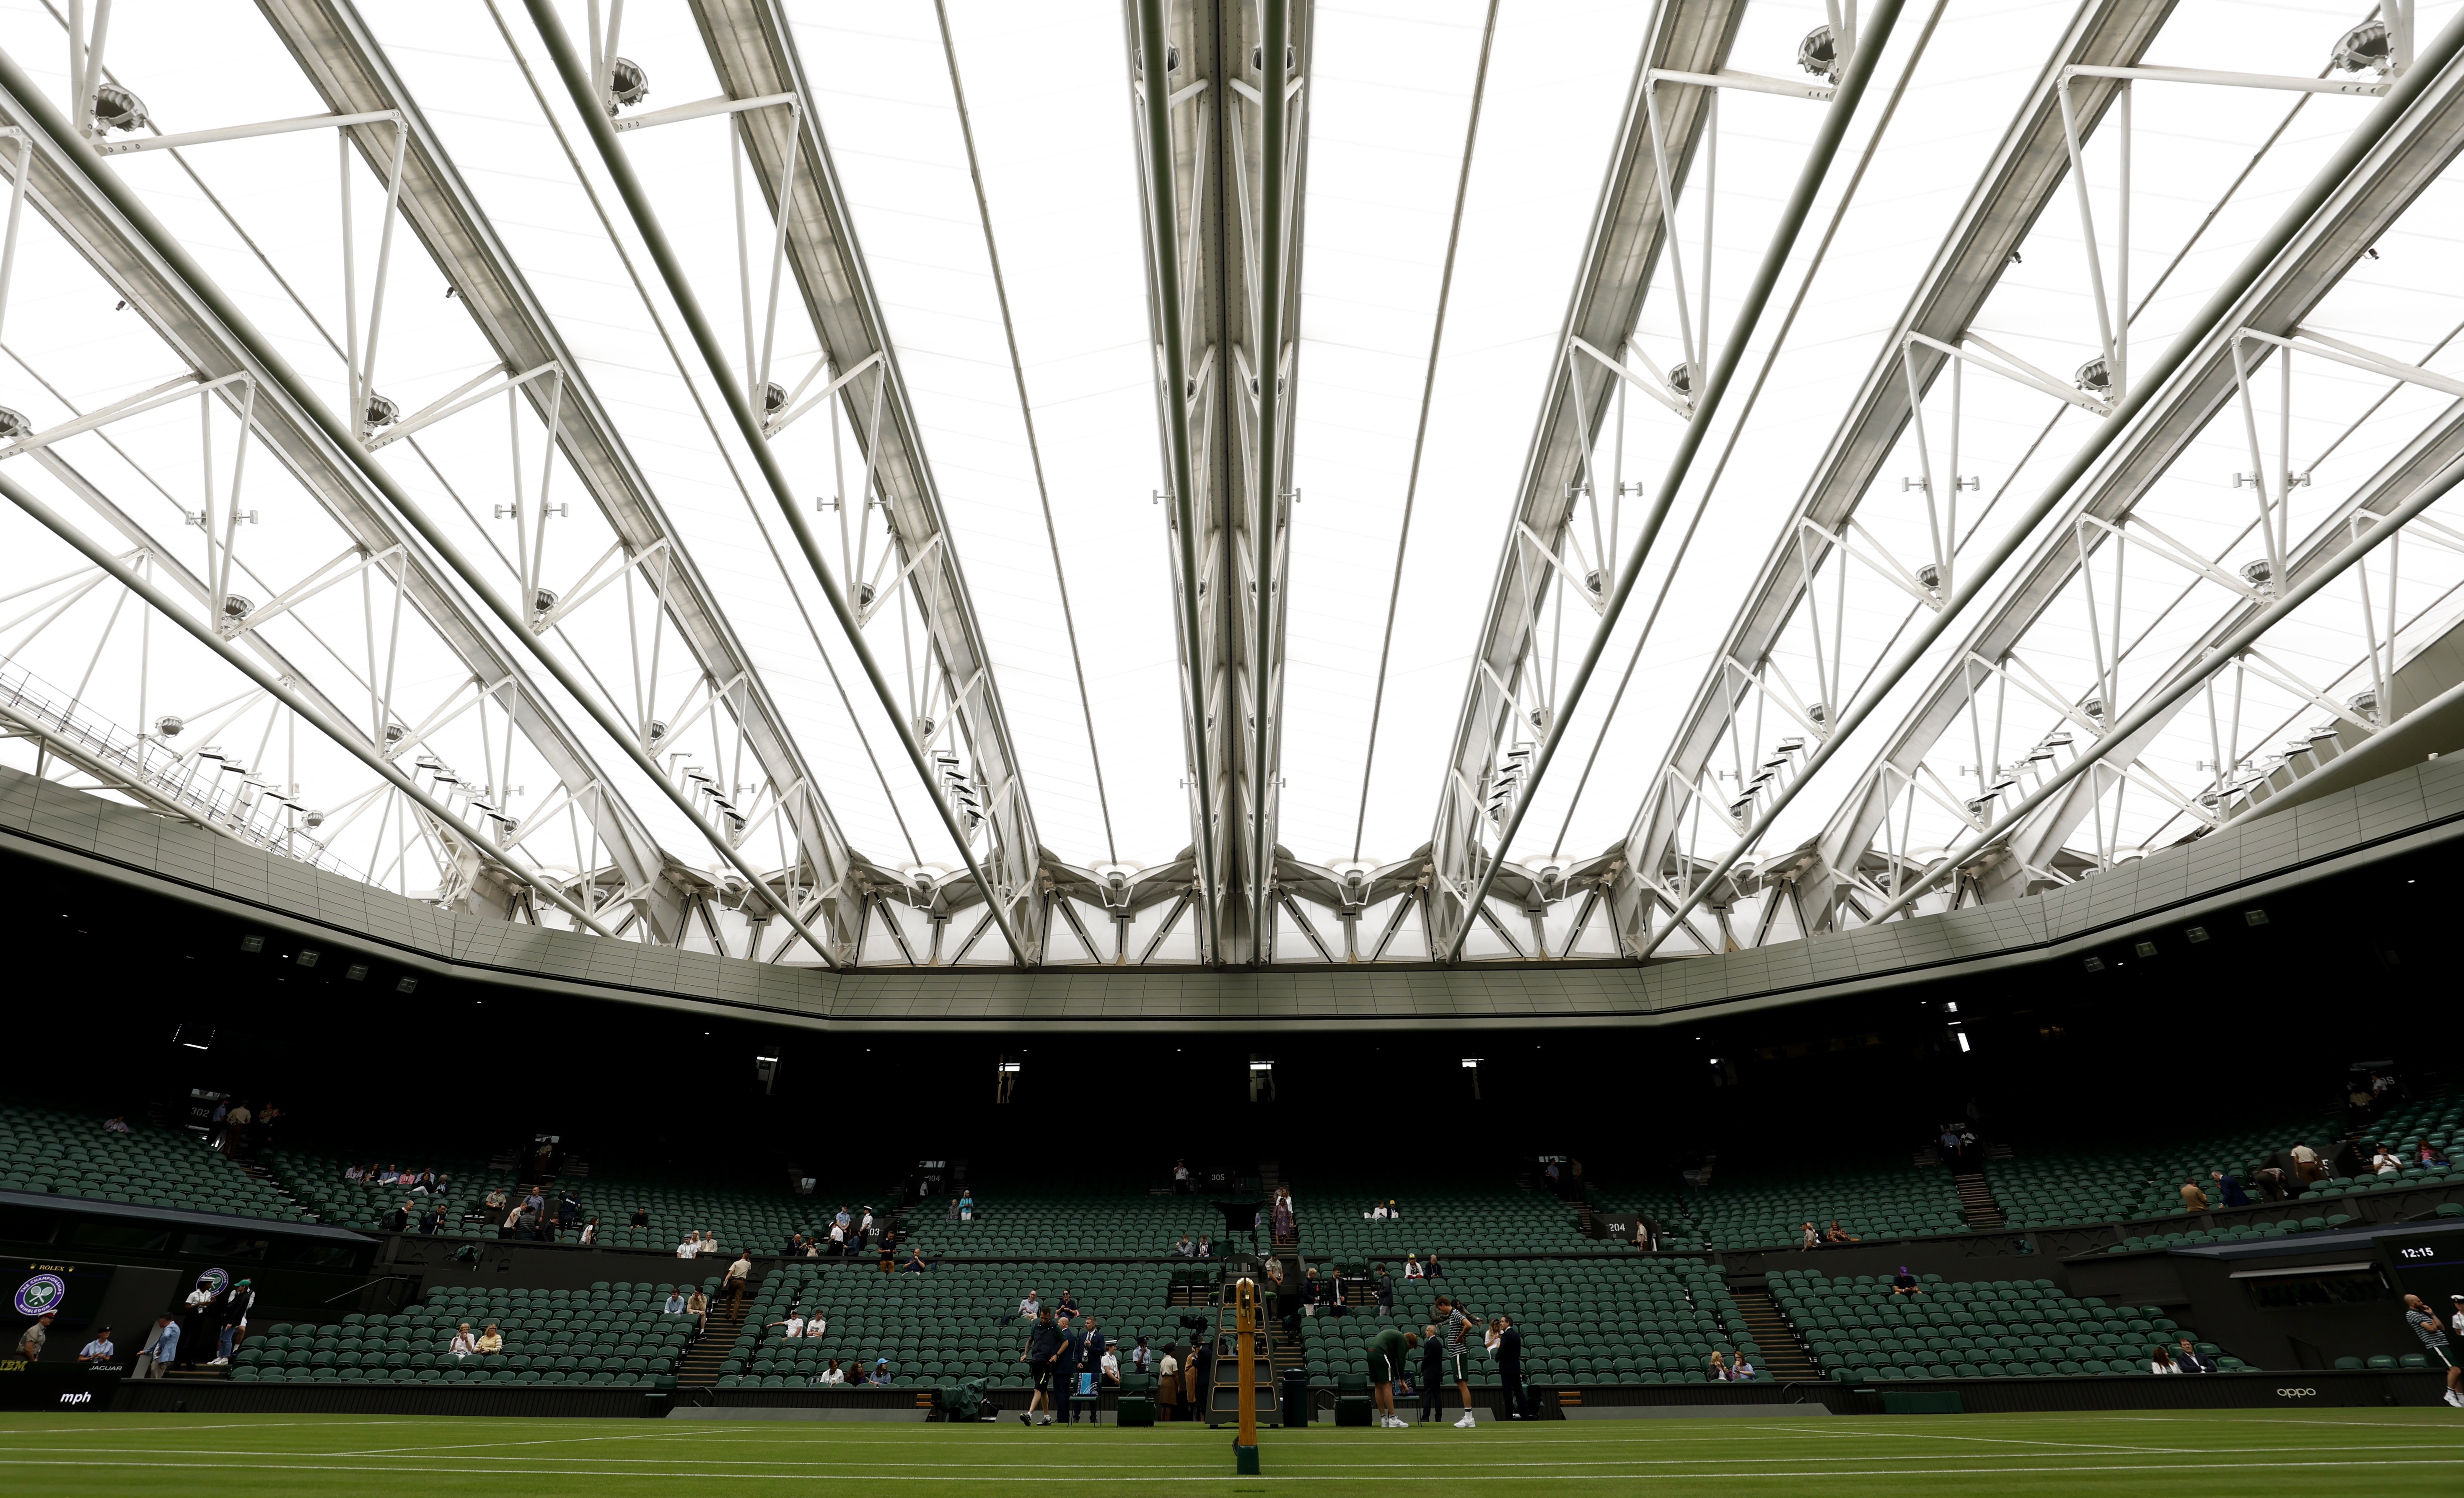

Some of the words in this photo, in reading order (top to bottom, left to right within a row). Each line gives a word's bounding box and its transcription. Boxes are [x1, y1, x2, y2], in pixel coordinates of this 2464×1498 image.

[191, 1107, 210, 1117] 302
[1609, 1223, 1626, 1231] 204
[2401, 1247, 2434, 1258] 12:15
[20, 1283, 31, 1293] THE
[30, 1276, 62, 1295] CHAMPIONSHIPS
[19, 1303, 50, 1314] WIMBLEDON
[0, 1360, 28, 1371] IBM
[60, 1391, 91, 1405] mph
[2276, 1388, 2316, 1398] oppo
